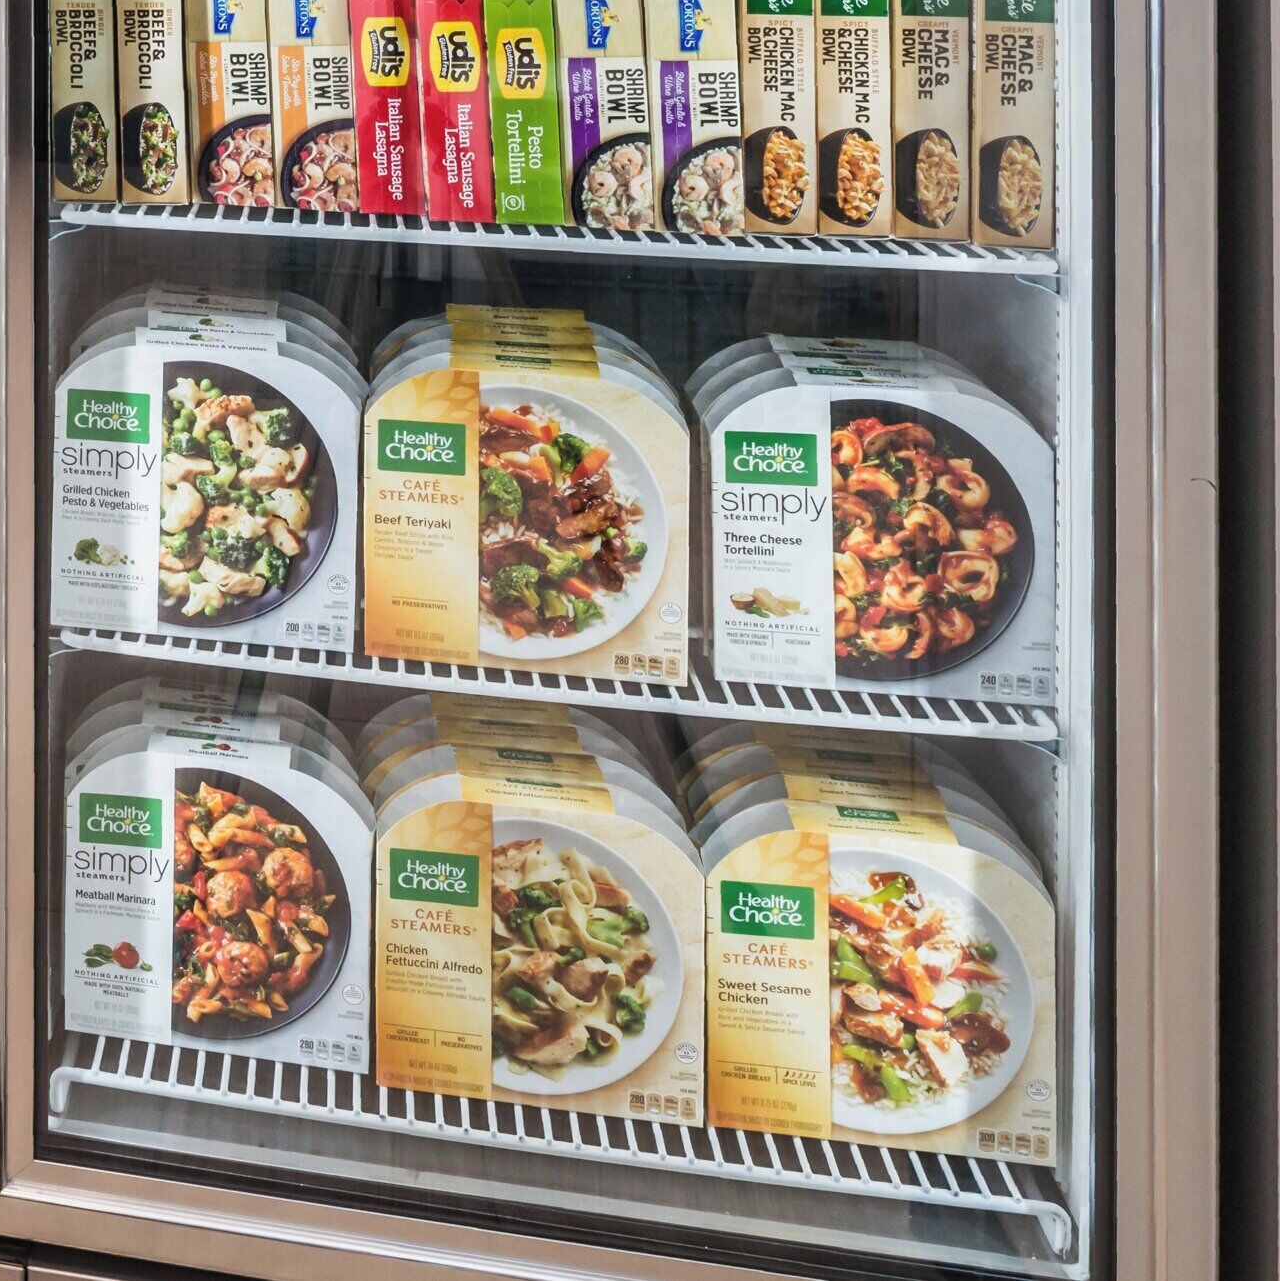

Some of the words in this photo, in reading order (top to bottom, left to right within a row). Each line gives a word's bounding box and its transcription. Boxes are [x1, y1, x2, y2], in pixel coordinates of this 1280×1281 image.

[124, 10, 136, 47] BOWL
[137, 10, 152, 90] BROCCOLI
[779, 26, 795, 88] CHICKEN
[230, 53, 249, 106] BOWL
[248, 53, 268, 106] SHRIMP
[780, 90, 795, 122] MAC
[388, 98, 402, 141] Italian
[374, 122, 388, 177] Lasagna
[506, 110, 525, 185] Tortellini
[528, 125, 544, 170] Pesto
[390, 145, 404, 201] Sausage
[83, 399, 138, 417] Healthy
[74, 412, 141, 432] Choice
[394, 429, 453, 448] Healthy
[385, 443, 456, 463] Choice
[742, 441, 803, 460] Healthy
[61, 442, 157, 480] simply
[733, 456, 806, 474] Choice
[63, 468, 113, 477] steamers
[63, 484, 92, 496] Grilled
[94, 486, 130, 498] Chicken
[403, 478, 441, 492] CAFÉ
[62, 496, 88, 507] Pesto
[89, 498, 96, 508] &
[97, 499, 149, 512] Vegetables
[379, 489, 460, 505] STEAMERS
[374, 514, 401, 525] Beef
[405, 516, 452, 530] Teriyaki
[724, 532, 756, 544] Three
[760, 534, 803, 545] Cheese
[724, 545, 775, 556] Tortellini
[61, 567, 97, 577] NOTHING
[99, 570, 145, 581] ARTIFICIAL
[95, 803, 150, 822] Healthy
[87, 817, 152, 836] Choice
[407, 859, 466, 879] Healthy
[397, 872, 468, 893] Choice
[76, 889, 114, 901] Meatball
[117, 892, 156, 906] Marinara
[738, 892, 800, 912] Healthy
[729, 906, 803, 927] Choice
[386, 942, 428, 956] Chicken
[386, 955, 439, 970] Fettuccini
[442, 960, 483, 975] Alfredo
[718, 978, 757, 993] Sweet
[761, 984, 812, 998] Sesame
[718, 992, 769, 1006] Chicken
